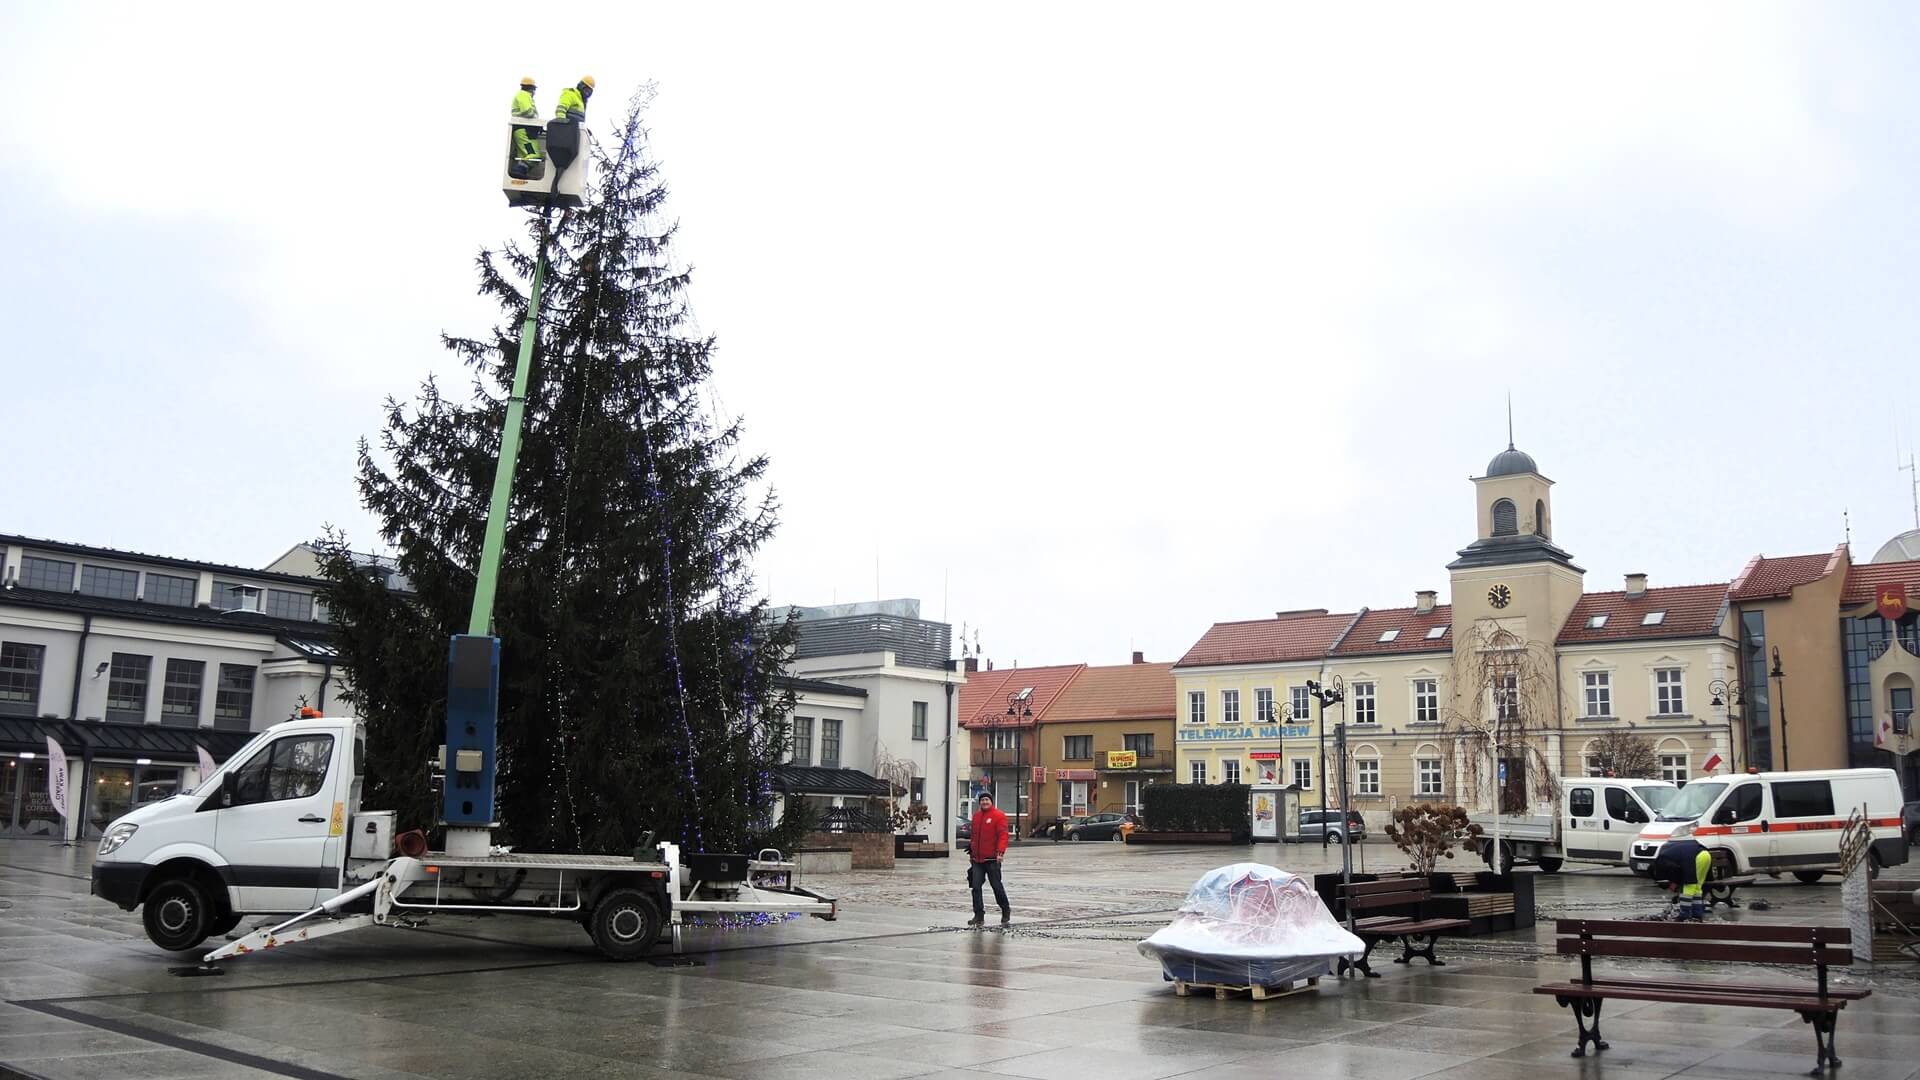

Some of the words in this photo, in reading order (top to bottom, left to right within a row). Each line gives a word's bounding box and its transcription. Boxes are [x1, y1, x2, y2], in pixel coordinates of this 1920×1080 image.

[1179, 727, 1254, 739] TELEWIZJA
[1260, 726, 1310, 738] NAREW
[29, 791, 49, 800] WHIT
